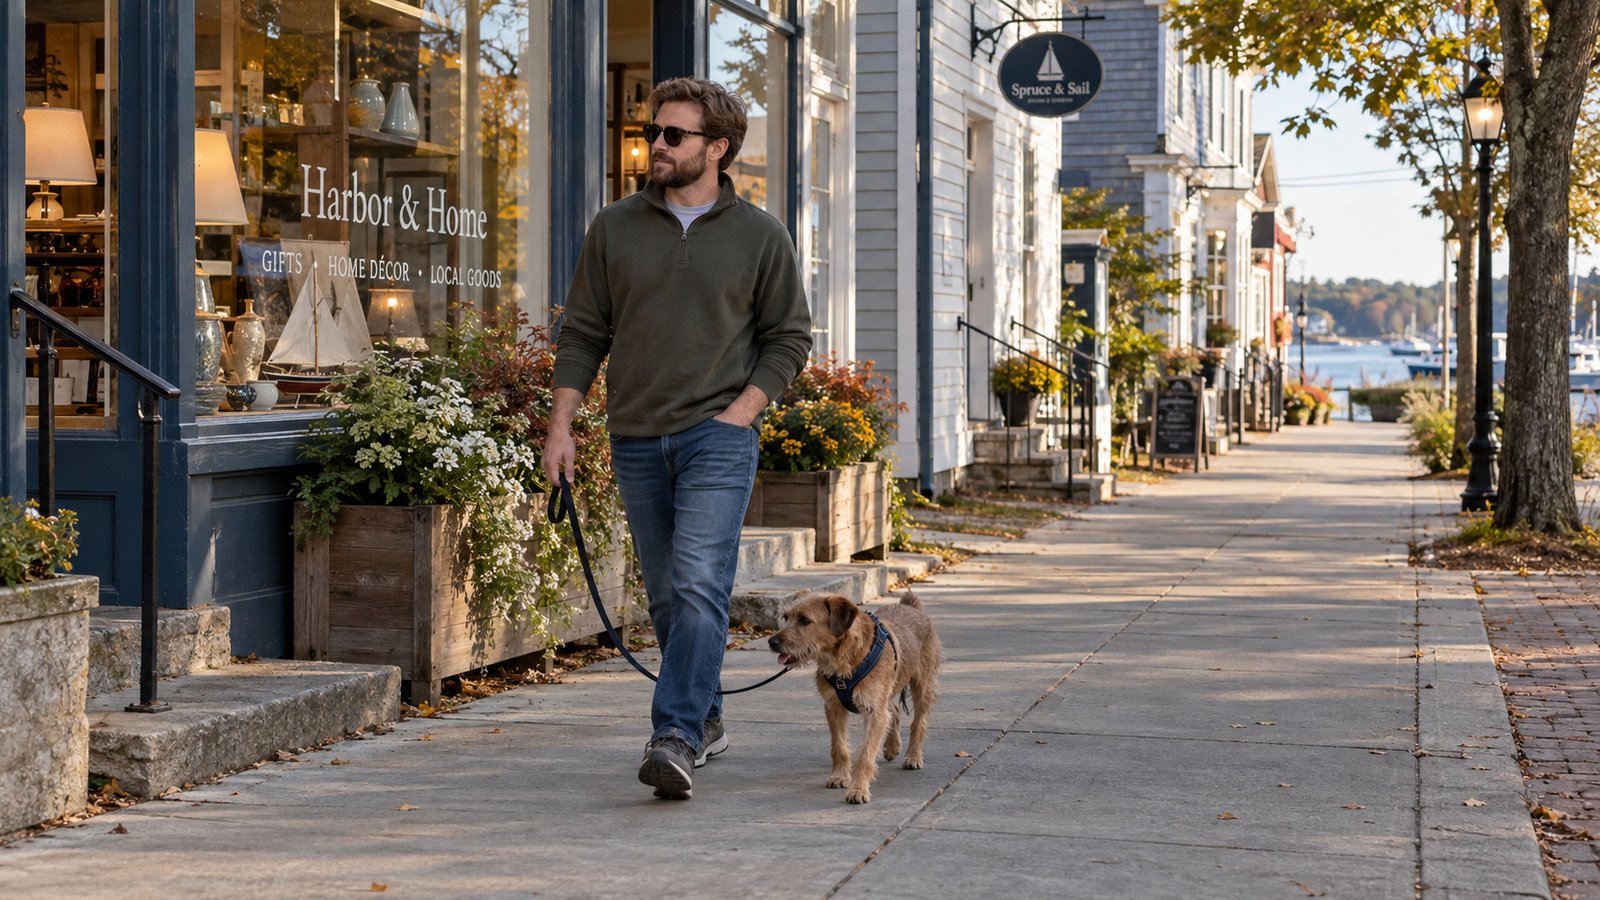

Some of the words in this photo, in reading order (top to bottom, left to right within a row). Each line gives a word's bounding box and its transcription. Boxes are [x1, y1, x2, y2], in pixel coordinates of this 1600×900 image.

[1011, 83, 1052, 99] Spruce
[1054, 83, 1065, 95] &
[1068, 82, 1091, 95] Sail
[301, 163, 393, 227] Harbor
[399, 184, 420, 232] &
[426, 186, 488, 240] Home
[262, 250, 302, 274] GIFTS
[328, 256, 366, 279] HOME
[370, 255, 410, 282] DÉCOR
[431, 265, 464, 286] LOCAL
[467, 268, 502, 289] GOODS
